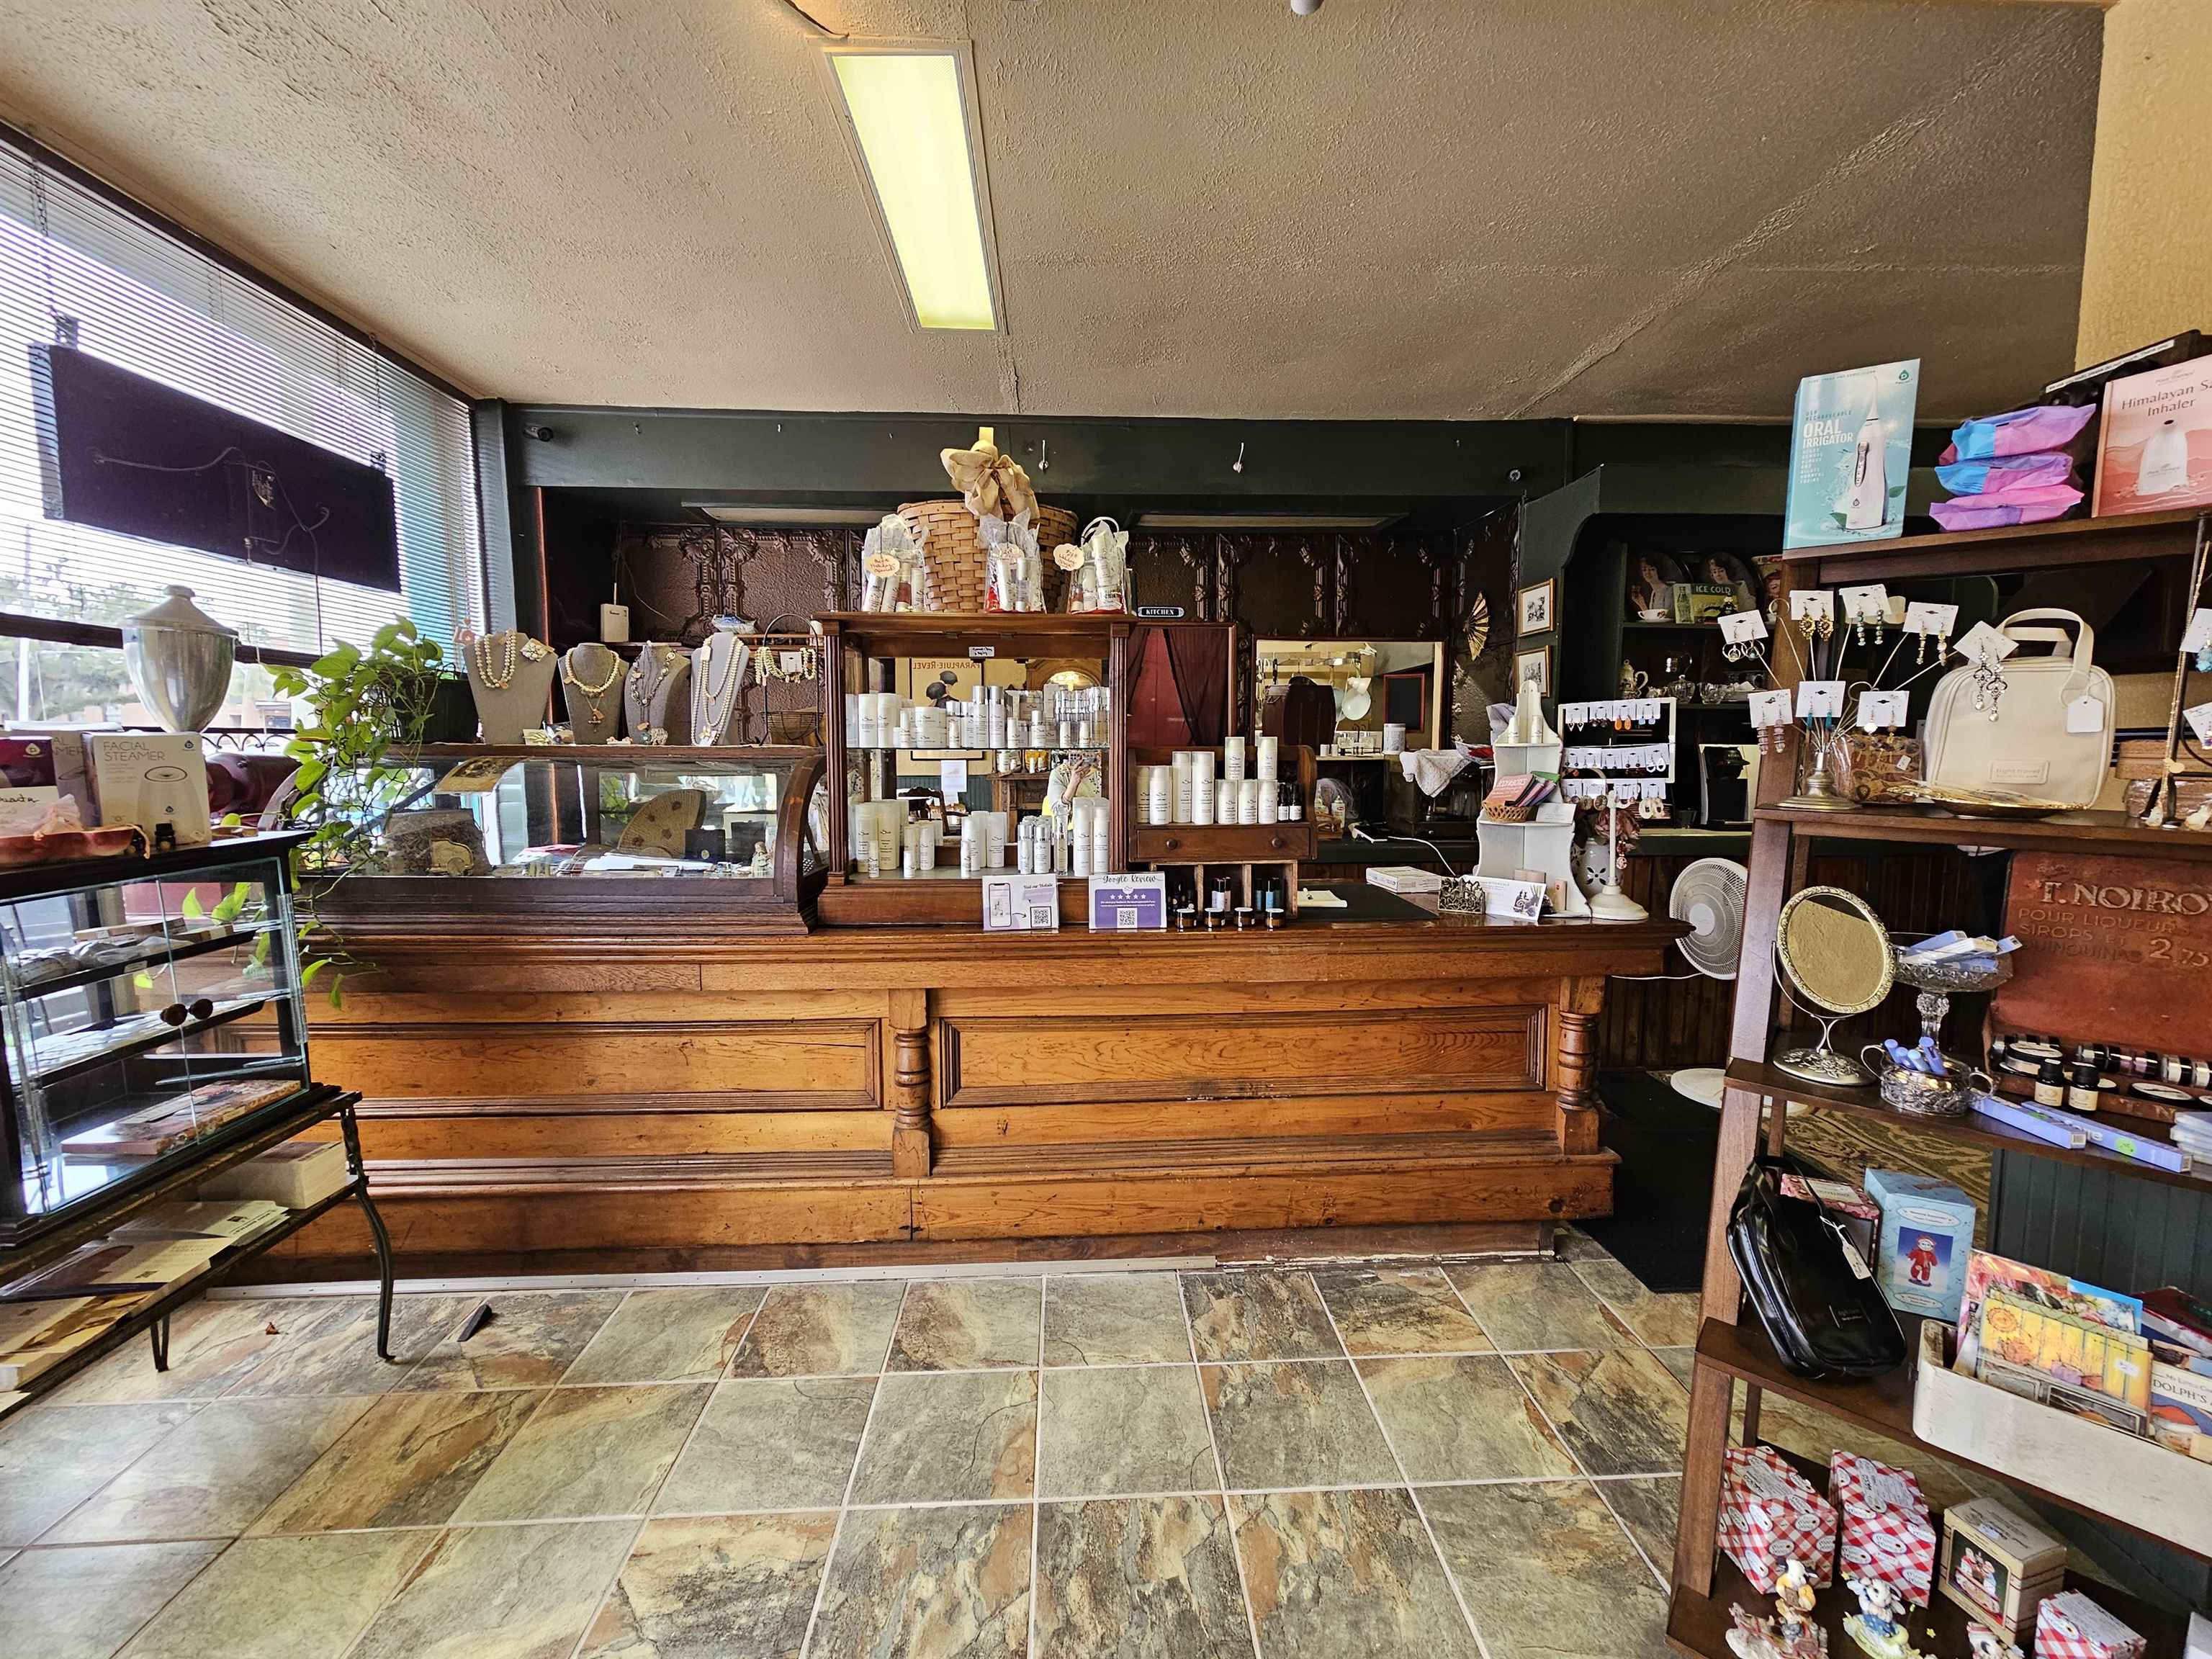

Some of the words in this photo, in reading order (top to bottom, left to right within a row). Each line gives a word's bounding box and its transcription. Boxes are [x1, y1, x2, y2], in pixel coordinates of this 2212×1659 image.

[2121, 385, 2193, 410] Himalayan
[2147, 398, 2197, 417] Inhaler
[1803, 419, 1842, 438] ORAL
[1803, 432, 1854, 449] IRRIGATOR
[103, 741, 150, 751] FACIAL
[104, 751, 166, 761] STEAMER
[1102, 875, 1128, 884] Google
[2019, 908, 2074, 923] POUR
[2019, 925, 2093, 940] SIROPS
[2106, 935, 2126, 945] ET
[2153, 1379, 2207, 1403] DOLPH'S
